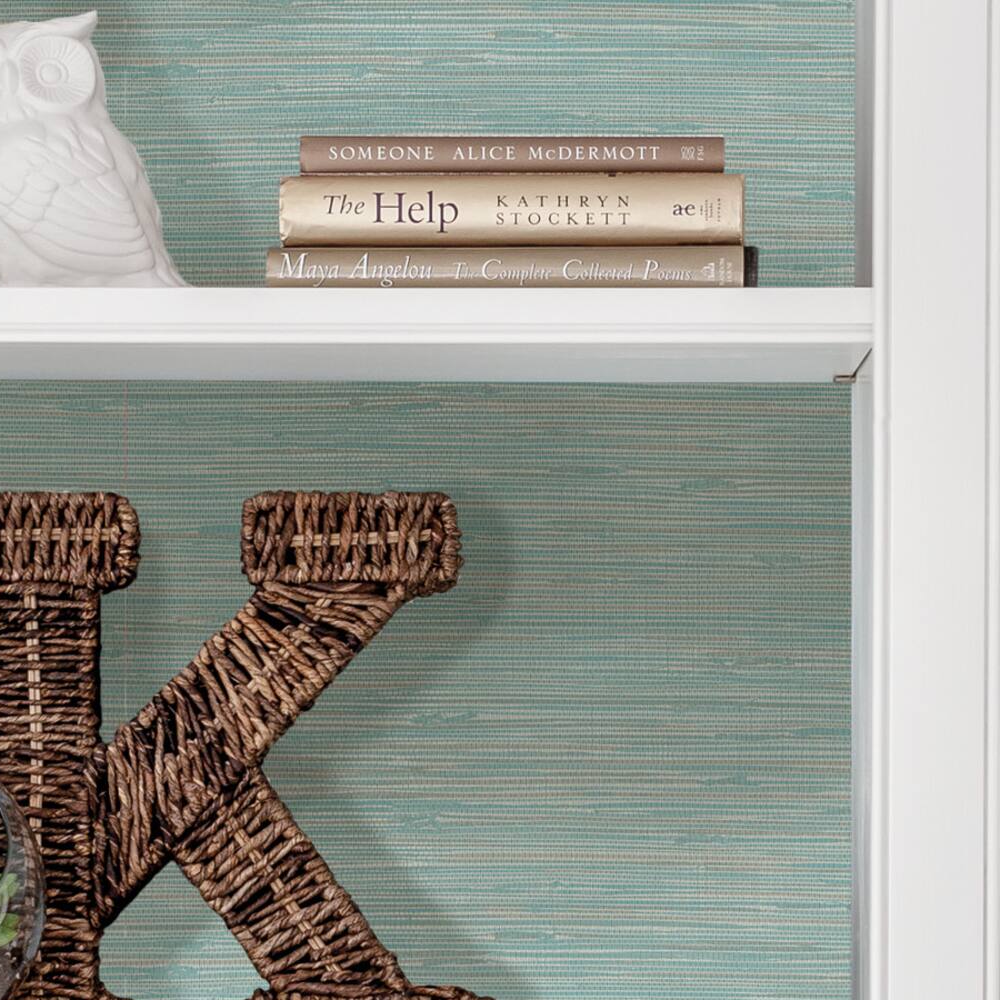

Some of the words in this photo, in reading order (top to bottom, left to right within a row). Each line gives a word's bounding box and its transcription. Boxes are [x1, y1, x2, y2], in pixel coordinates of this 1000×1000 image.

[328, 146, 434, 160] SOMEONE
[452, 146, 516, 161] ALICE
[528, 146, 661, 161] McDERMOTT
[496, 195, 630, 208] KATHRYN
[323, 193, 365, 215] The
[372, 190, 459, 234] Help
[495, 212, 631, 225] STOCKETT
[279, 252, 339, 287] Maya
[350, 252, 432, 287] Angelou
[453, 262, 480, 281] The
[481, 258, 552, 285] Complete
[562, 258, 633, 281] Collected
[643, 259, 692, 281] Poems
